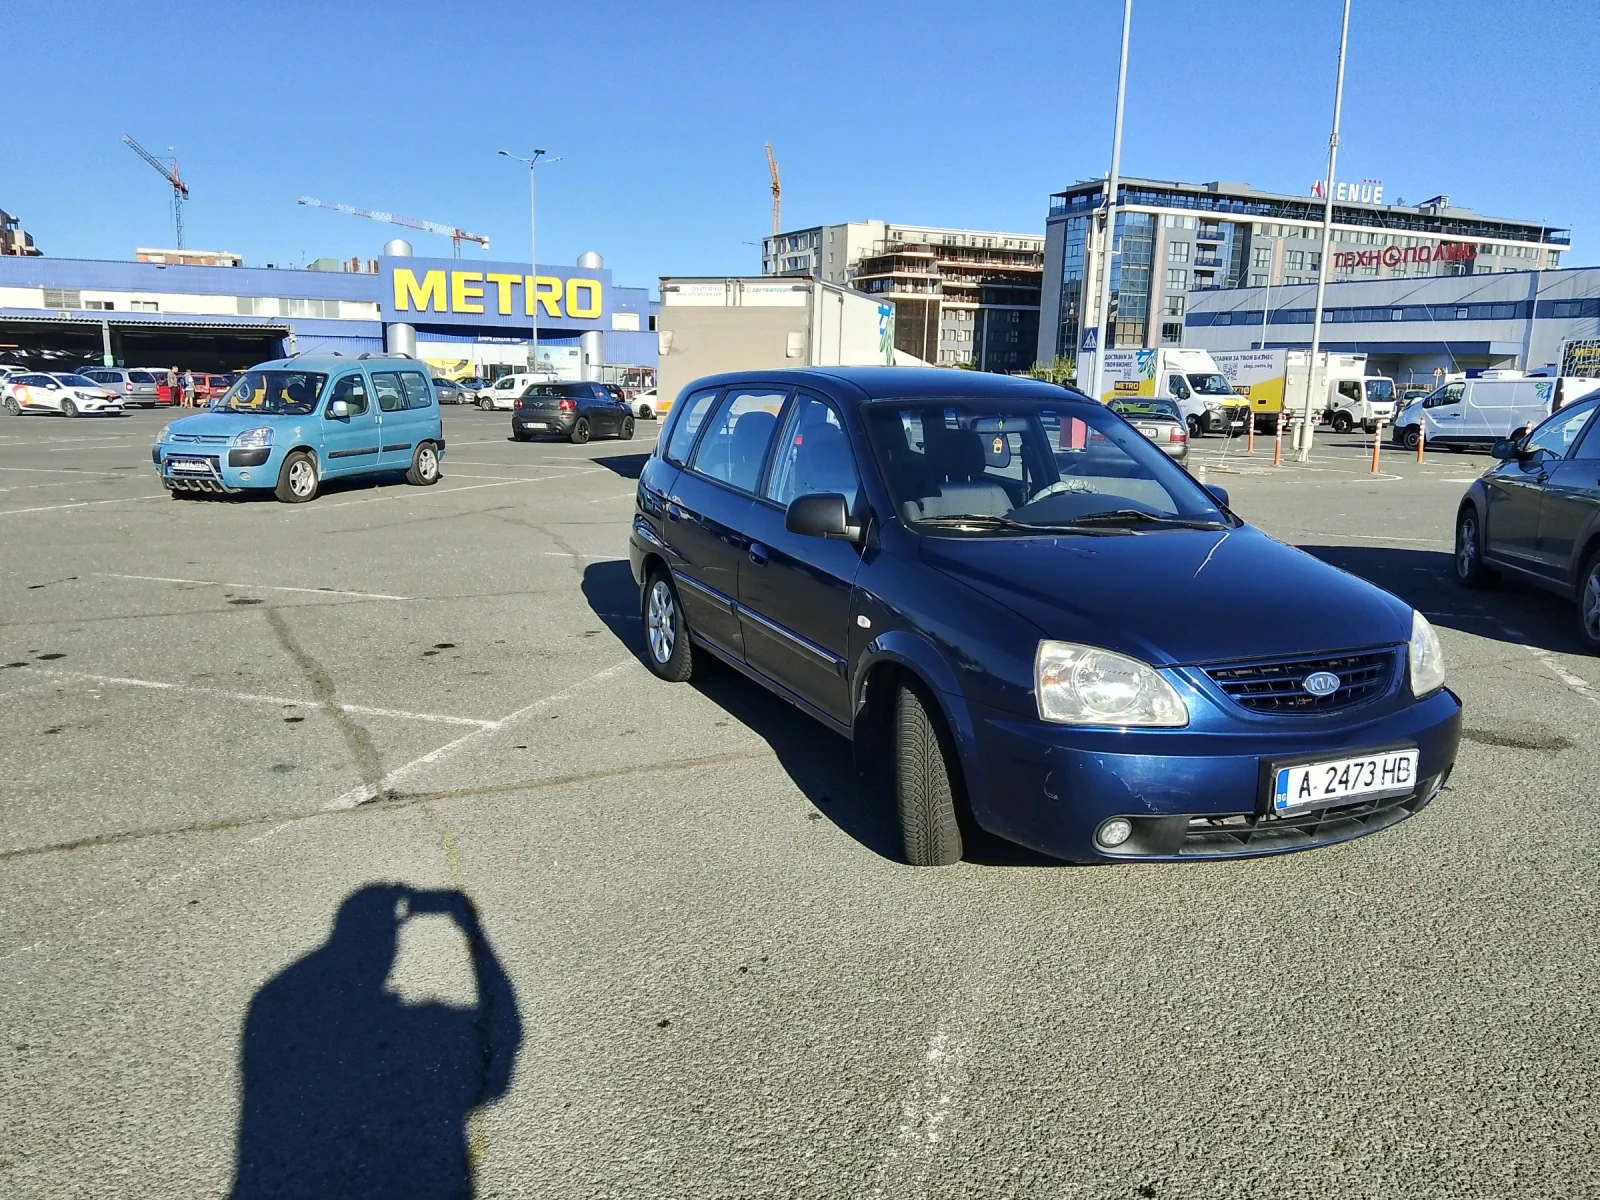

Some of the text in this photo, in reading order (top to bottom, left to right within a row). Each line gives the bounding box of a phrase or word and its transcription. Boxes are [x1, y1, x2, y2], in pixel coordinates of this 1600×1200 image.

[1333, 242, 1479, 268] ТЕХНОПОЛИС
[393, 268, 603, 319] METRO
[1253, 353, 1274, 361] БИЗНЕС
[1115, 382, 1139, 390] METRO
[1309, 677, 1335, 691] KIA
[1298, 756, 1411, 799] A 2473 HB
[1277, 793, 1287, 802] BG
